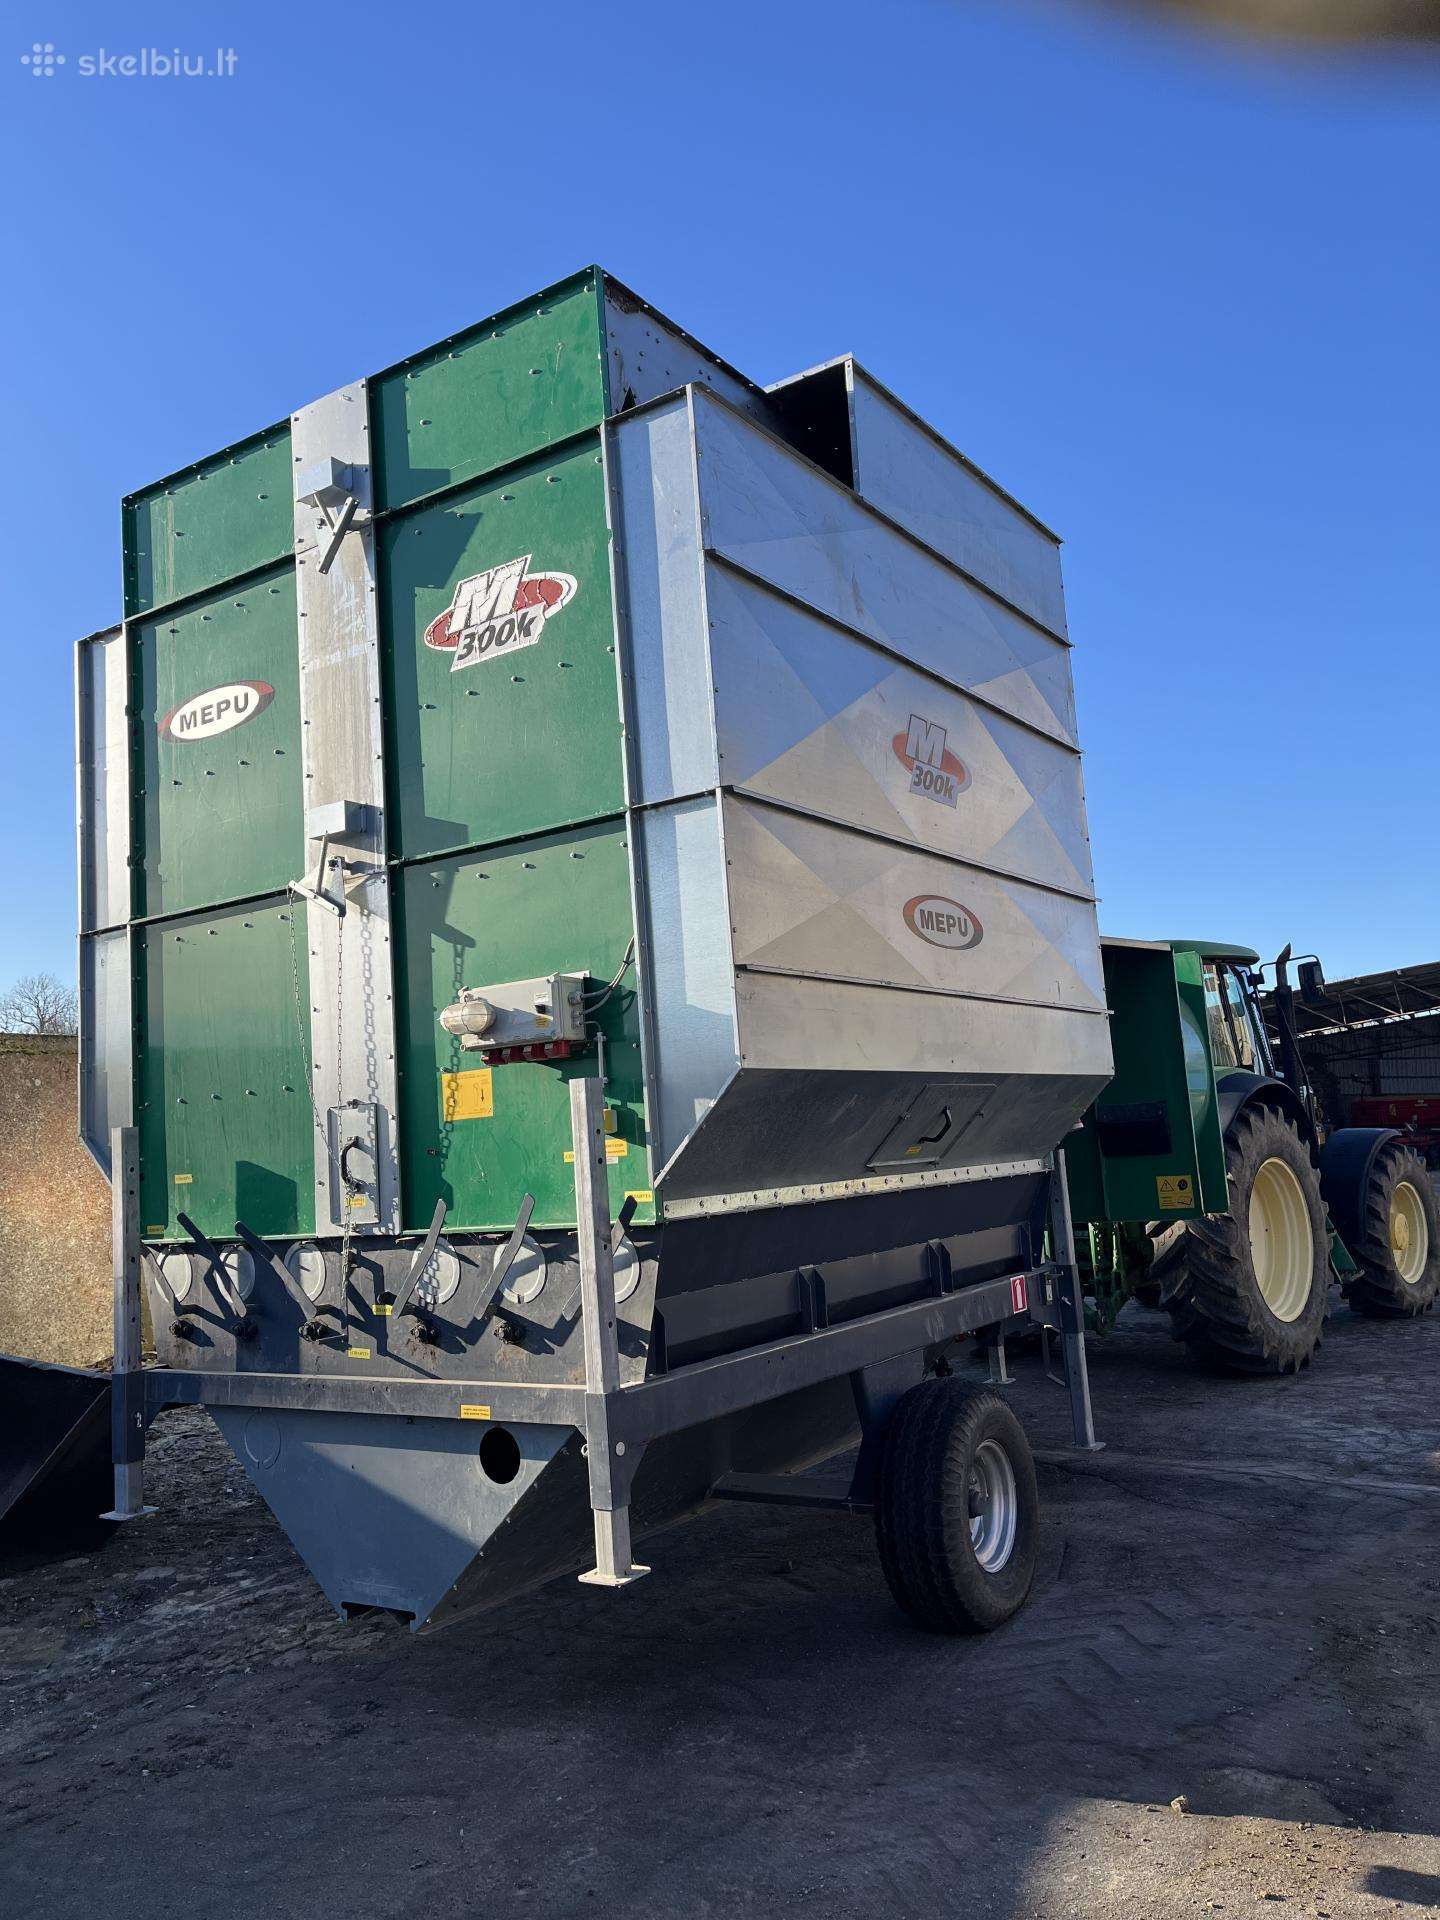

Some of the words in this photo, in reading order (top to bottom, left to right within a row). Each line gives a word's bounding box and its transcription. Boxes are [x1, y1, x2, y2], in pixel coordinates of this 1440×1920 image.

[179, 692, 249, 733] MEPU
[904, 713, 947, 770] M
[919, 908, 969, 938] MEPU
